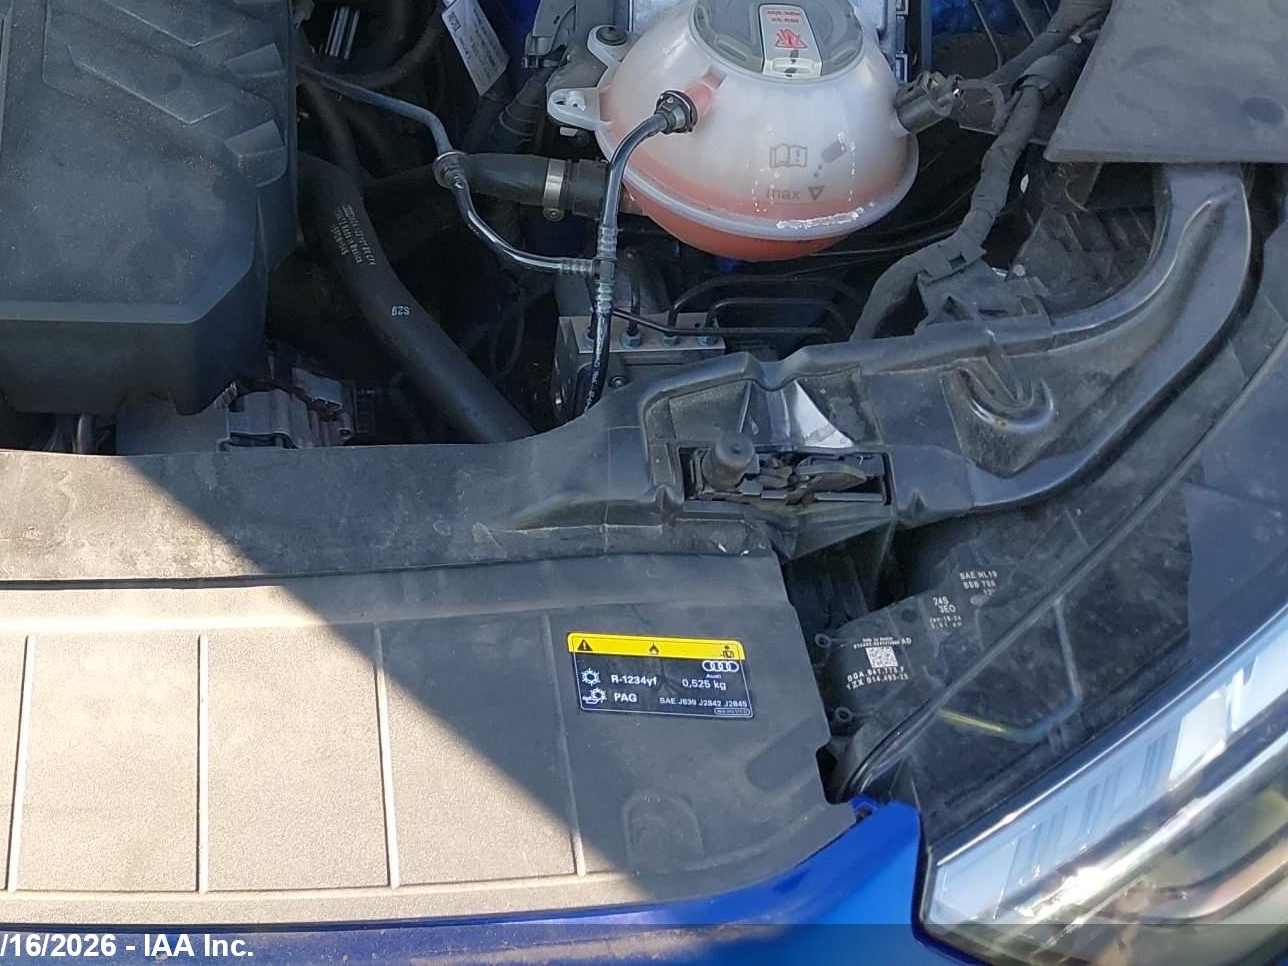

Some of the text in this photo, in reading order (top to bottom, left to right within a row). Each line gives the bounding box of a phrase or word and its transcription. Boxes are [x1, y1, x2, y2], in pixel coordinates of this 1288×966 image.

[765, 188, 800, 201] max
[610, 674, 658, 687] R-1234yf
[682, 678, 727, 691] 0,525 kg
[613, 692, 638, 703] PAG
[659, 697, 676, 705] SAE
